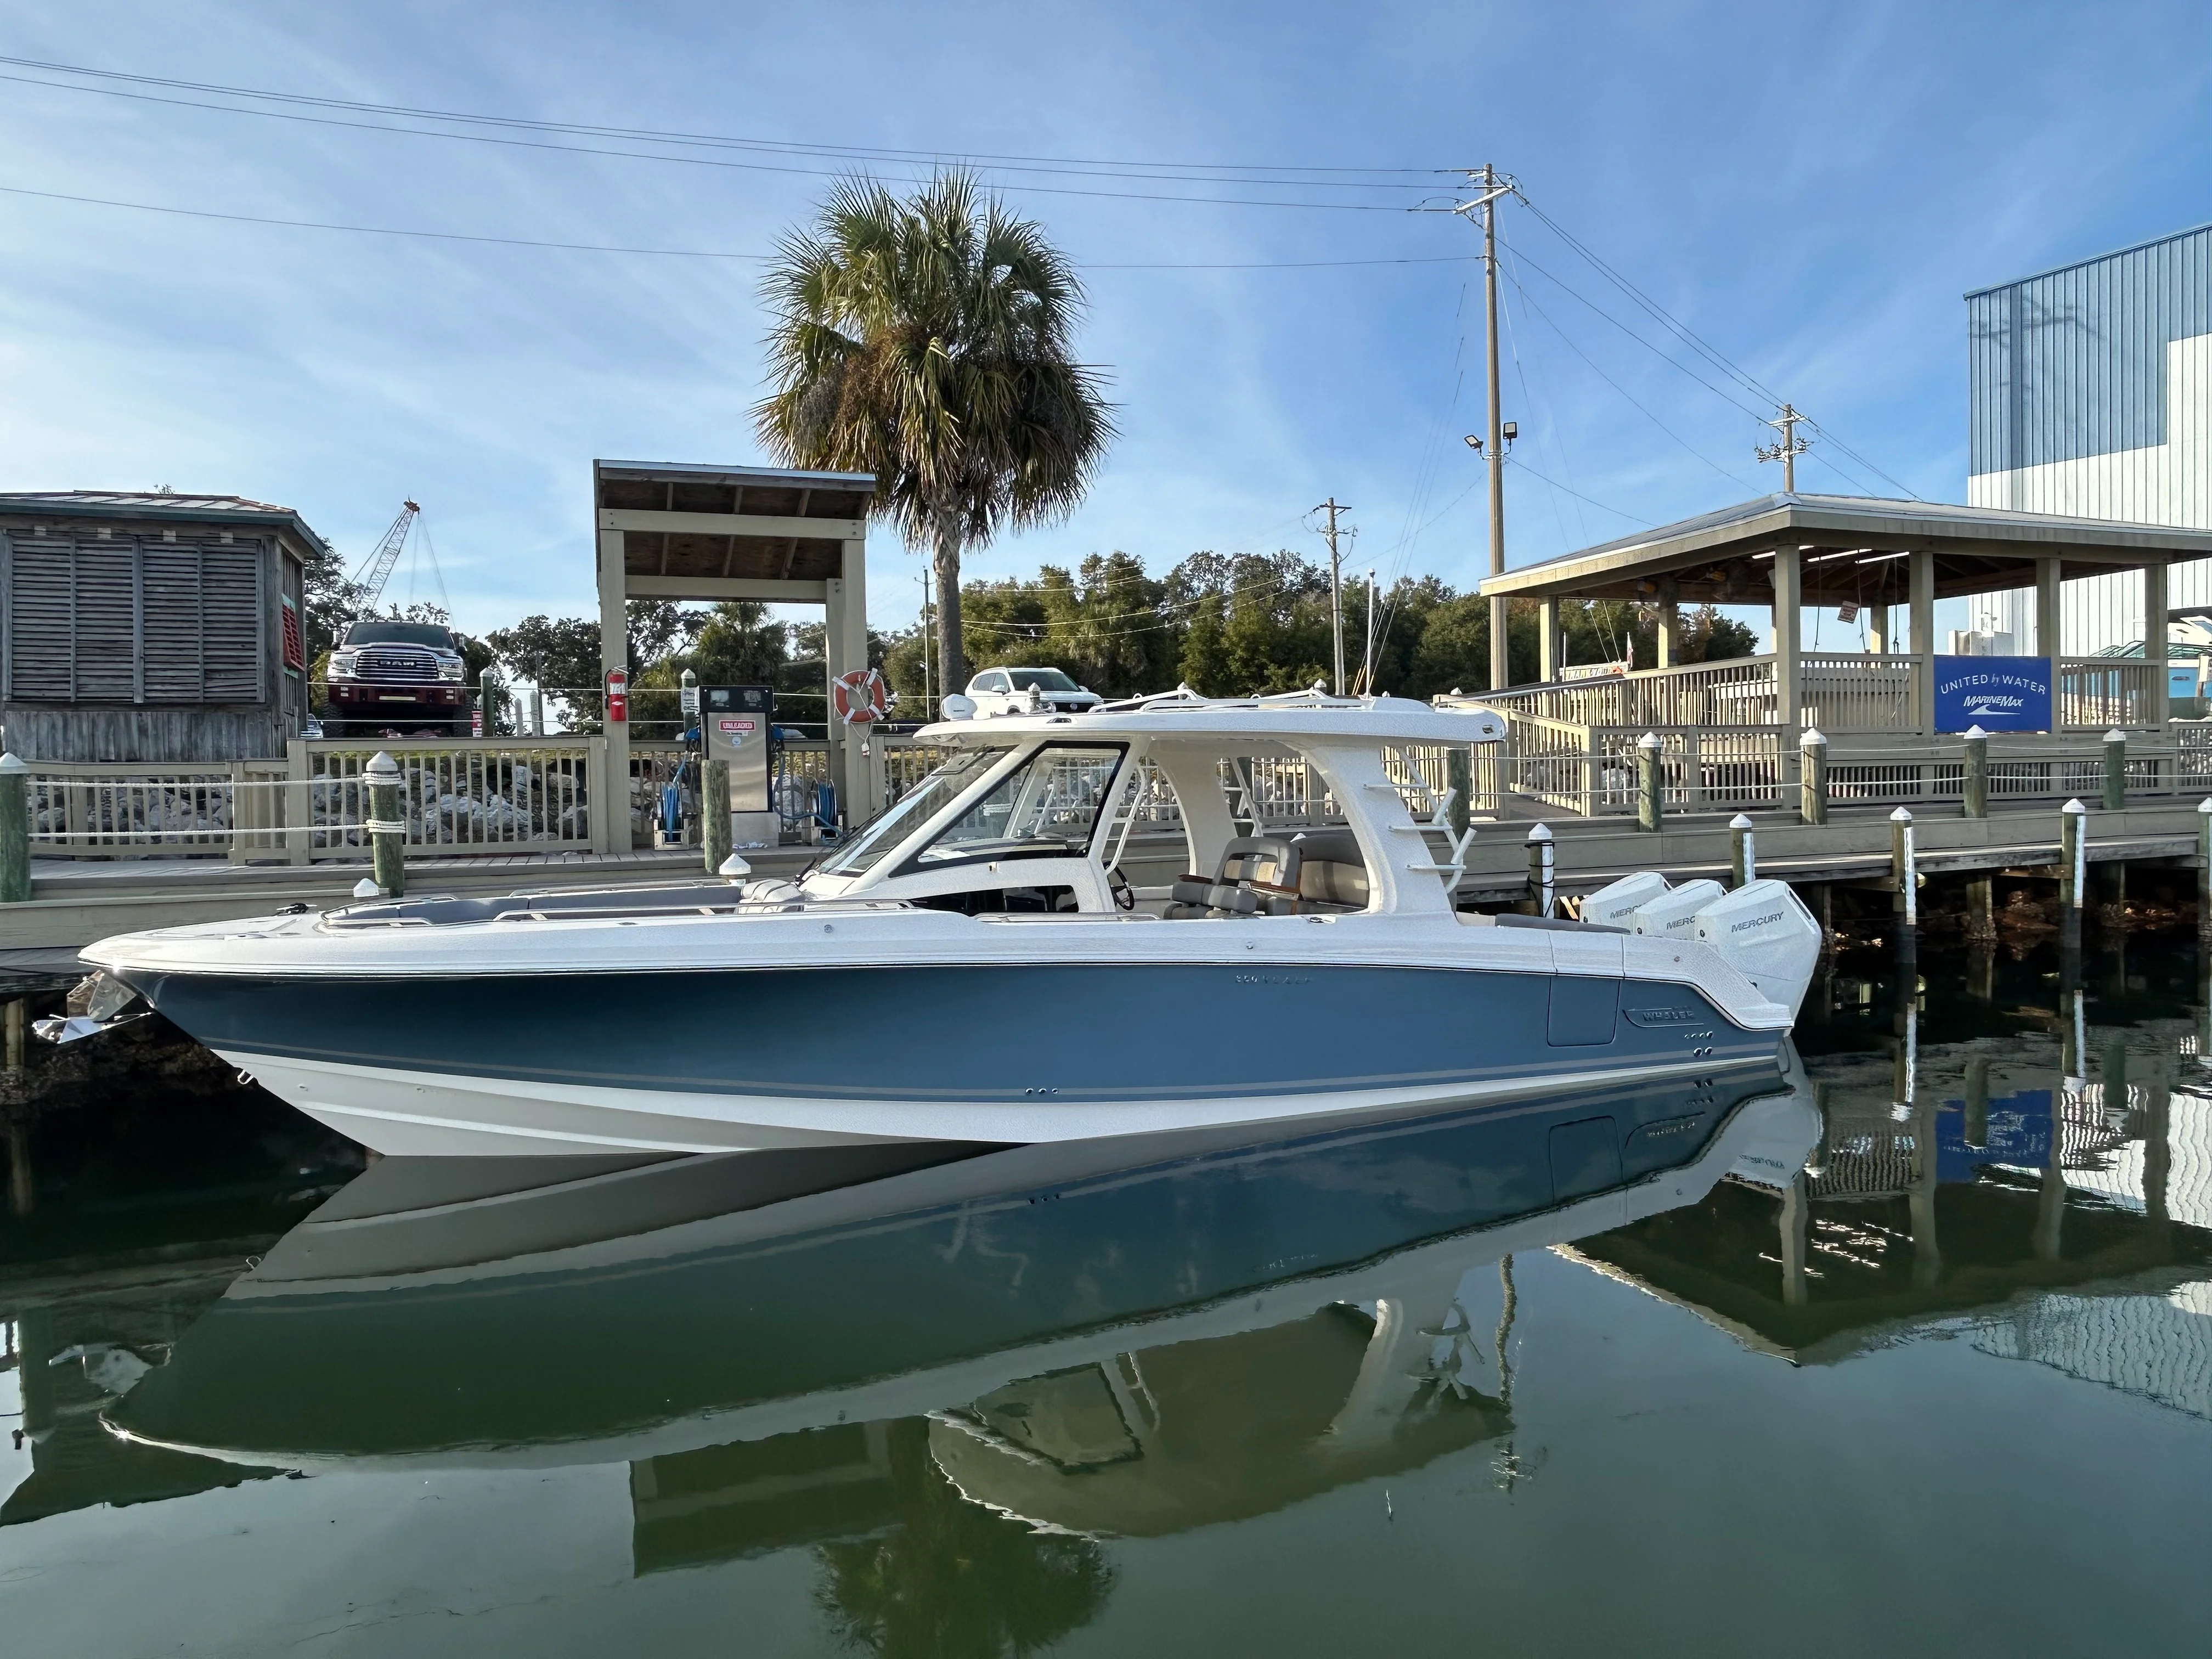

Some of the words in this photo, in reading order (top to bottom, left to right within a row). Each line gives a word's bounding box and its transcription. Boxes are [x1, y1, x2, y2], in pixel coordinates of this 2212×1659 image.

[1941, 674, 1988, 695] UNITED
[1991, 673, 2000, 687] by
[2002, 674, 2046, 695] WATER
[1610, 904, 1641, 919] MERC
[1667, 916, 1695, 930] MERC
[1731, 911, 1784, 933] MERCURY
